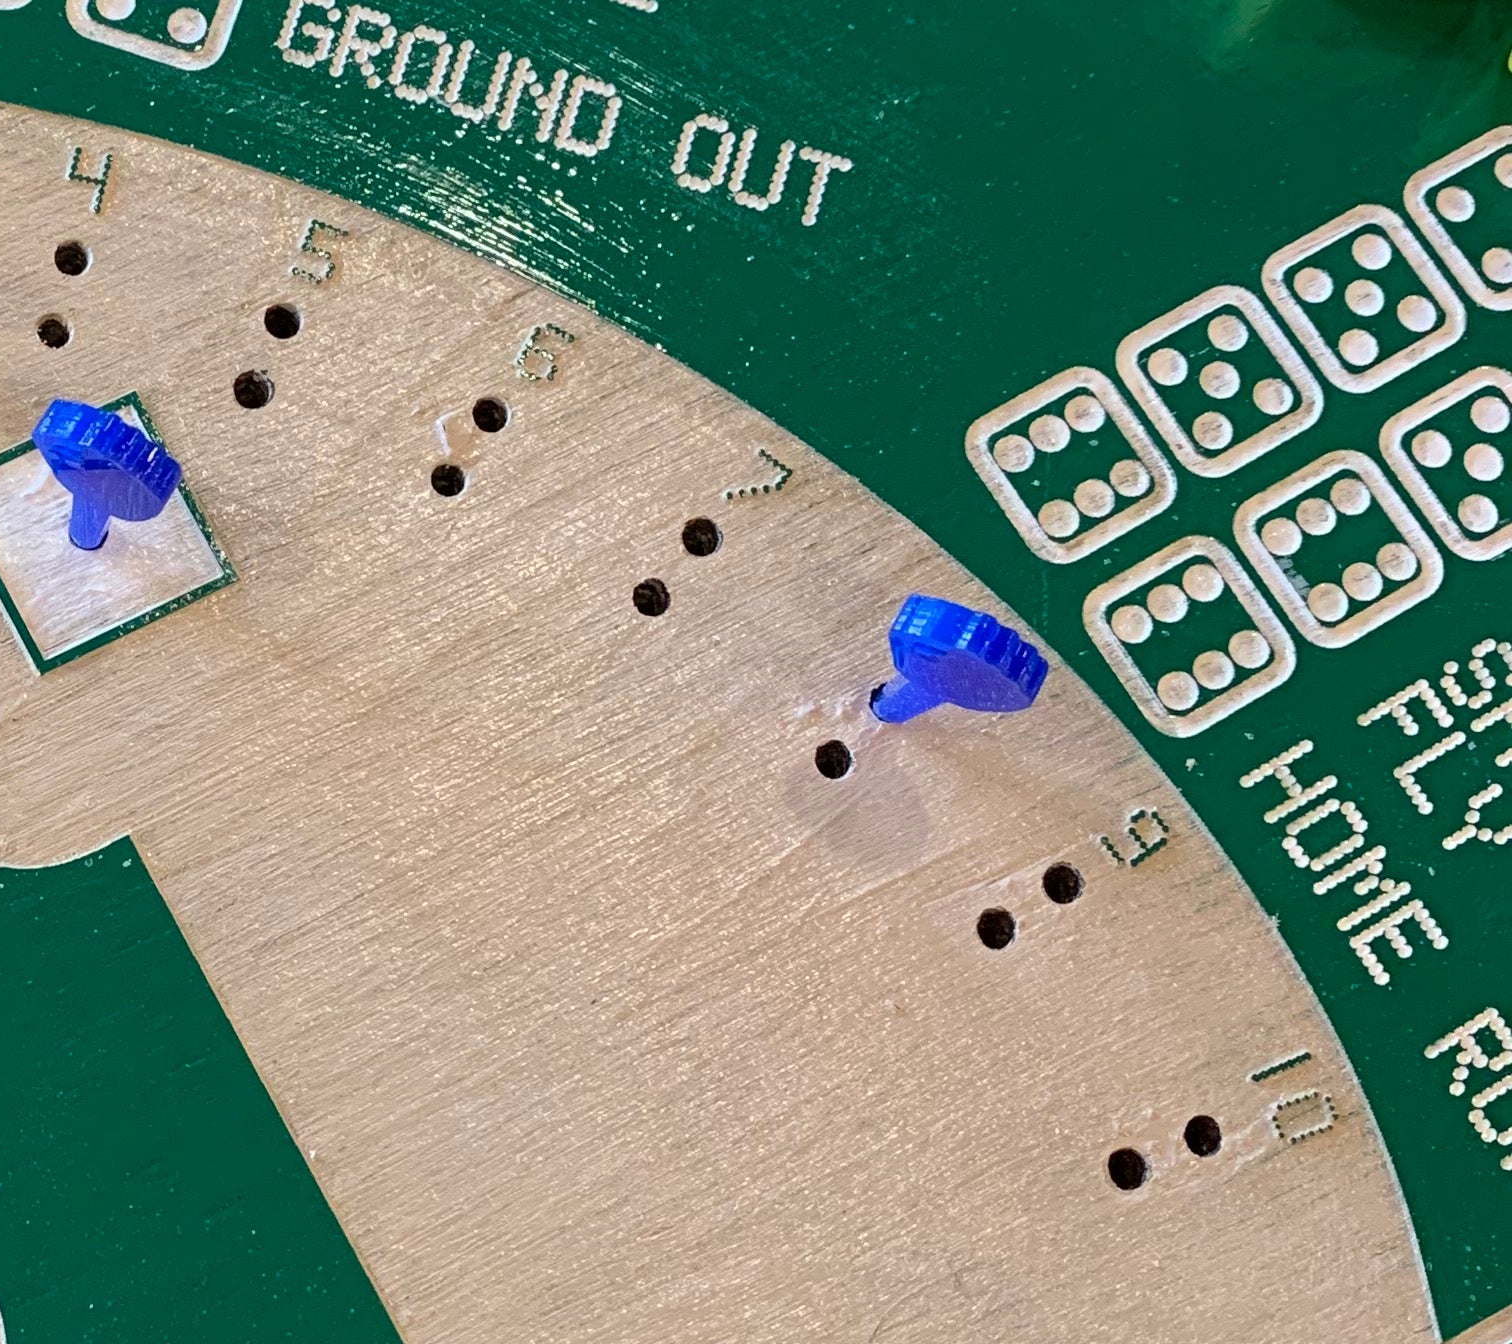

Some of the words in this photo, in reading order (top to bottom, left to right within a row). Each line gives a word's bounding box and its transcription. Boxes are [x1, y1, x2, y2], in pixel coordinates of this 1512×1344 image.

[671, 114, 852, 226] OUT
[67, 145, 114, 216] 4
[290, 217, 349, 286] 5
[516, 322, 576, 382] 6
[724, 447, 794, 502] 7
[1099, 807, 1170, 869] 9
[1248, 1051, 1340, 1146] 10
[1240, 740, 1448, 985] HOME
